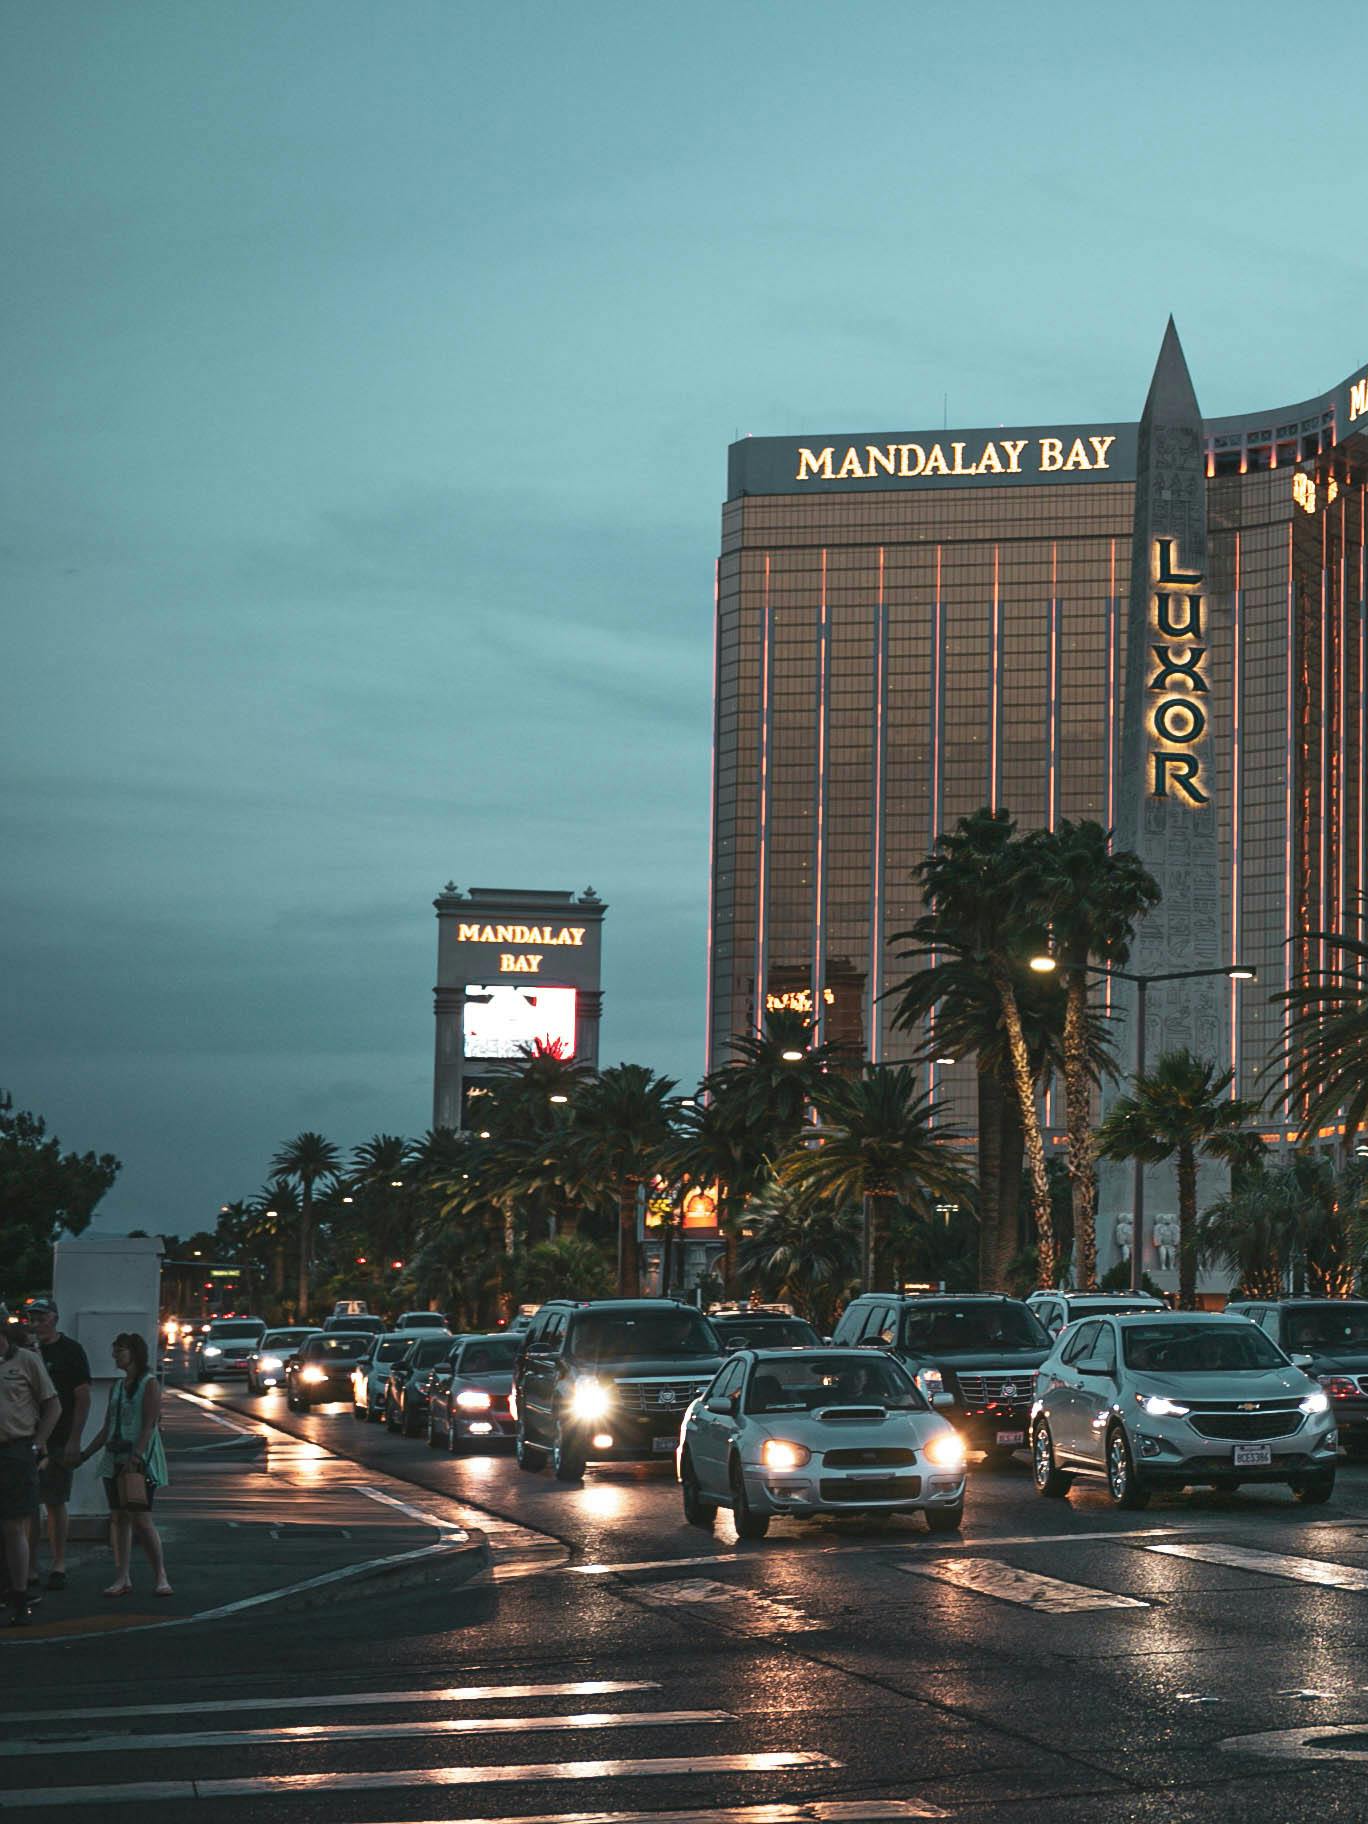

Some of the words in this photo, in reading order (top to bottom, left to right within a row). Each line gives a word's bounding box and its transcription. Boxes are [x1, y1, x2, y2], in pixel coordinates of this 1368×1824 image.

[796, 440, 1028, 480] MANDALAY
[1038, 436, 1116, 472] BAY
[1148, 537, 1211, 804] LUXOR
[457, 923, 586, 946] MANDALAY
[499, 953, 543, 973] BAY
